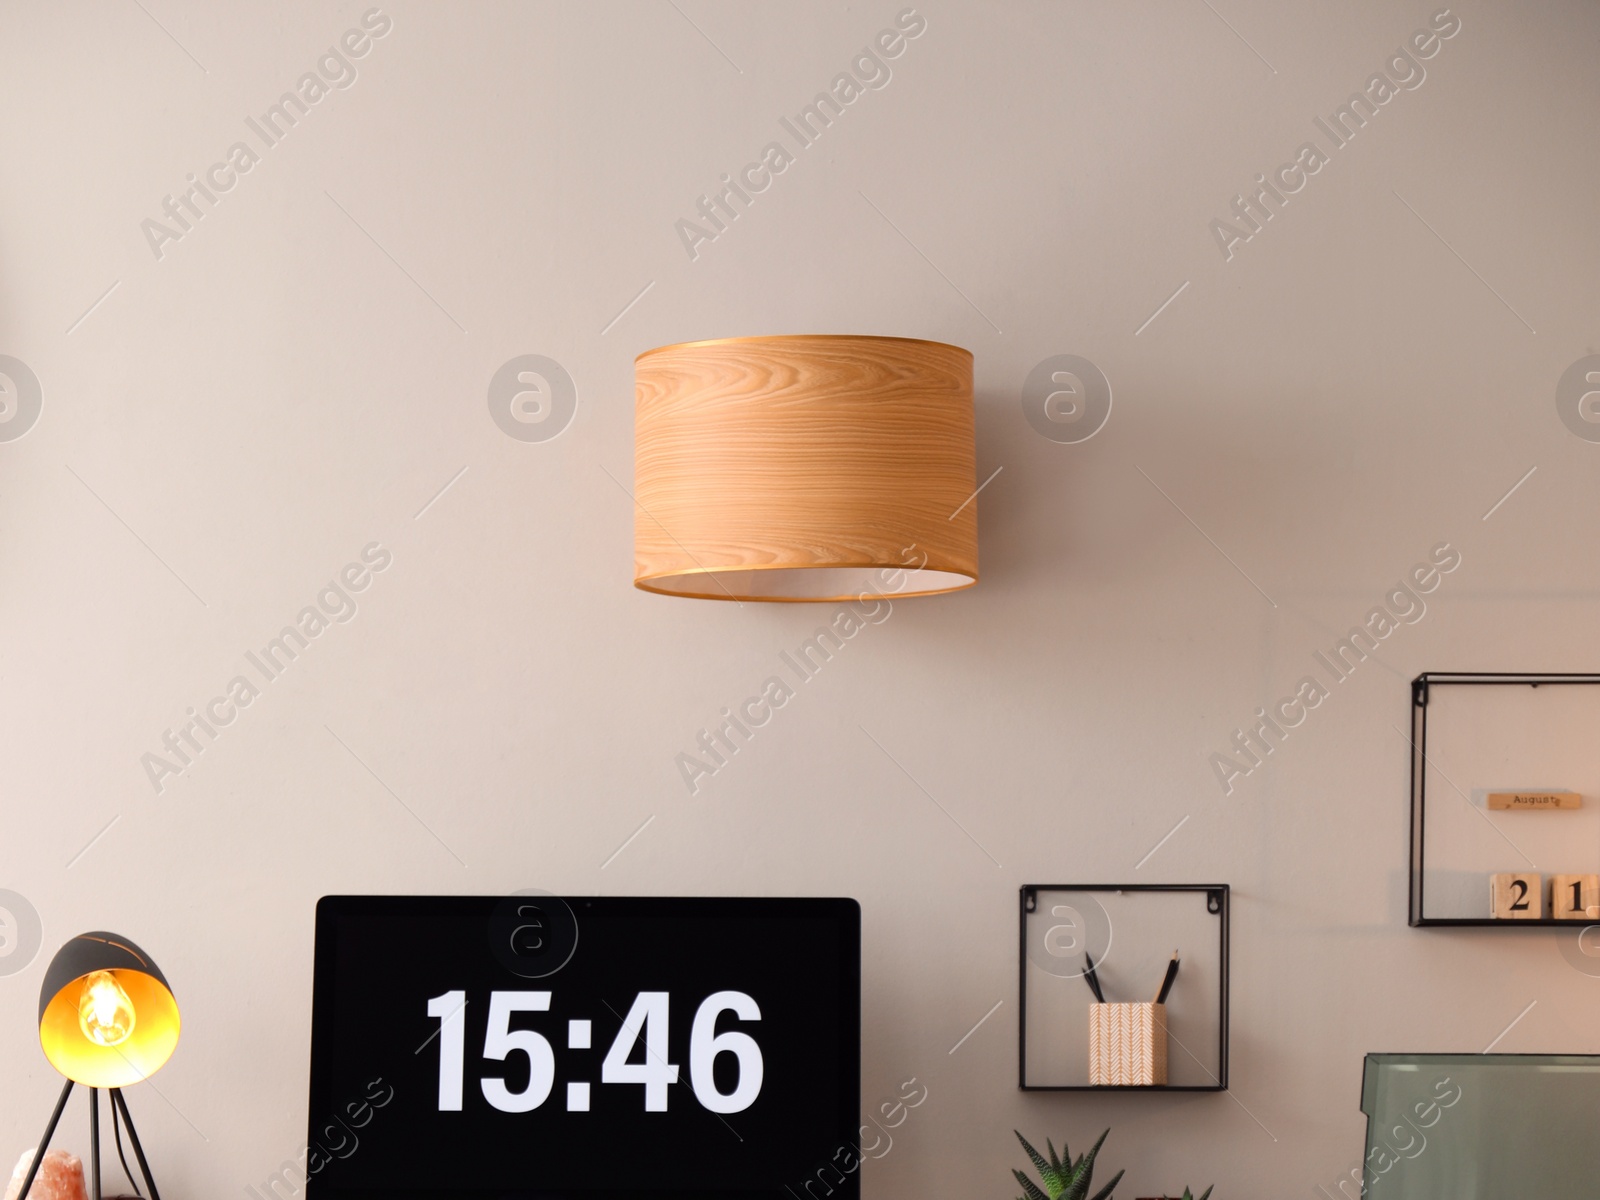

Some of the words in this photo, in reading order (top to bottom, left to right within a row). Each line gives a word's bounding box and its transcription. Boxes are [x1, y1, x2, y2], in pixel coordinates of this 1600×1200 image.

[1513, 795, 1556, 805] August
[1509, 879, 1530, 911] 2
[1568, 880, 1585, 912] 1
[427, 990, 764, 1114] 15:46
